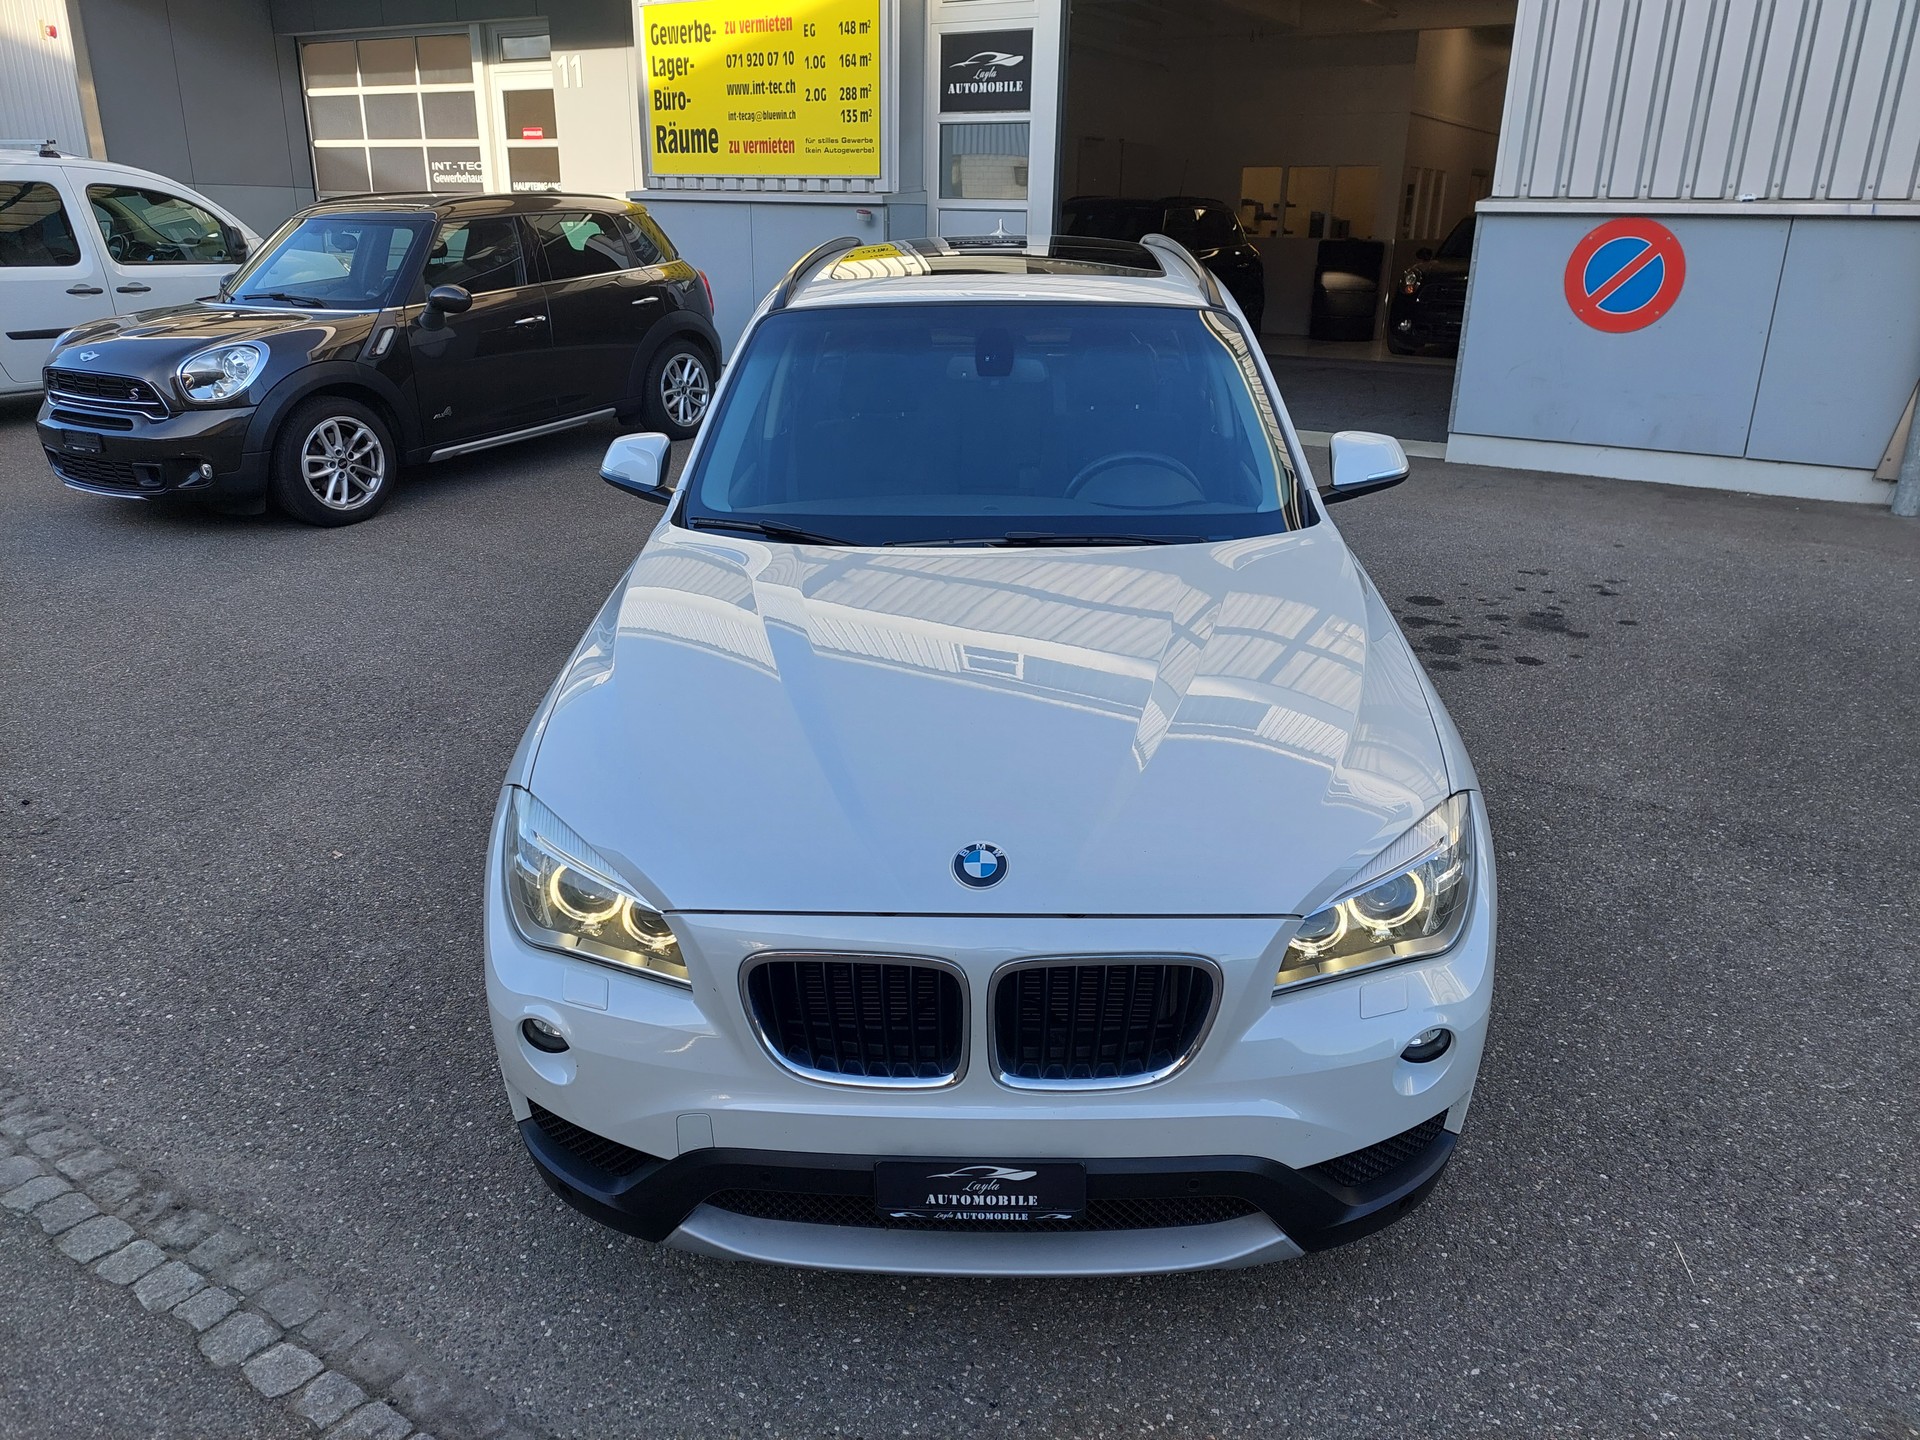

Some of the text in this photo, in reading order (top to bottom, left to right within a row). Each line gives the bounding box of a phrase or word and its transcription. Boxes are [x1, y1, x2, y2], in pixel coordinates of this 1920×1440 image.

[650, 19, 717, 45] Gewerbe-
[724, 16, 793, 34] zu vermieten
[803, 24, 816, 37] EG
[838, 22, 856, 35] 148
[726, 51, 794, 68] 071 920 07 10
[839, 54, 857, 67] 164
[556, 54, 583, 88] 11
[652, 56, 694, 81] Lager-
[726, 79, 796, 96] www.int-tec.ch
[840, 87, 857, 100] 288
[947, 80, 1024, 94] AUTOMOBILE
[654, 87, 691, 111] Büro-
[728, 110, 796, 122] int-tecag@bluewin.ch
[841, 109, 857, 123] 135
[656, 122, 719, 153] Räume
[728, 137, 795, 154] zu vermieten
[824, 147, 875, 155] Autogewerbe)
[958, 843, 1004, 858] BMW
[962, 1179, 1000, 1194] Layla
[926, 1194, 1038, 1206] AUTOMOBILE
[955, 1212, 1029, 1221] AUTOMOBILE
